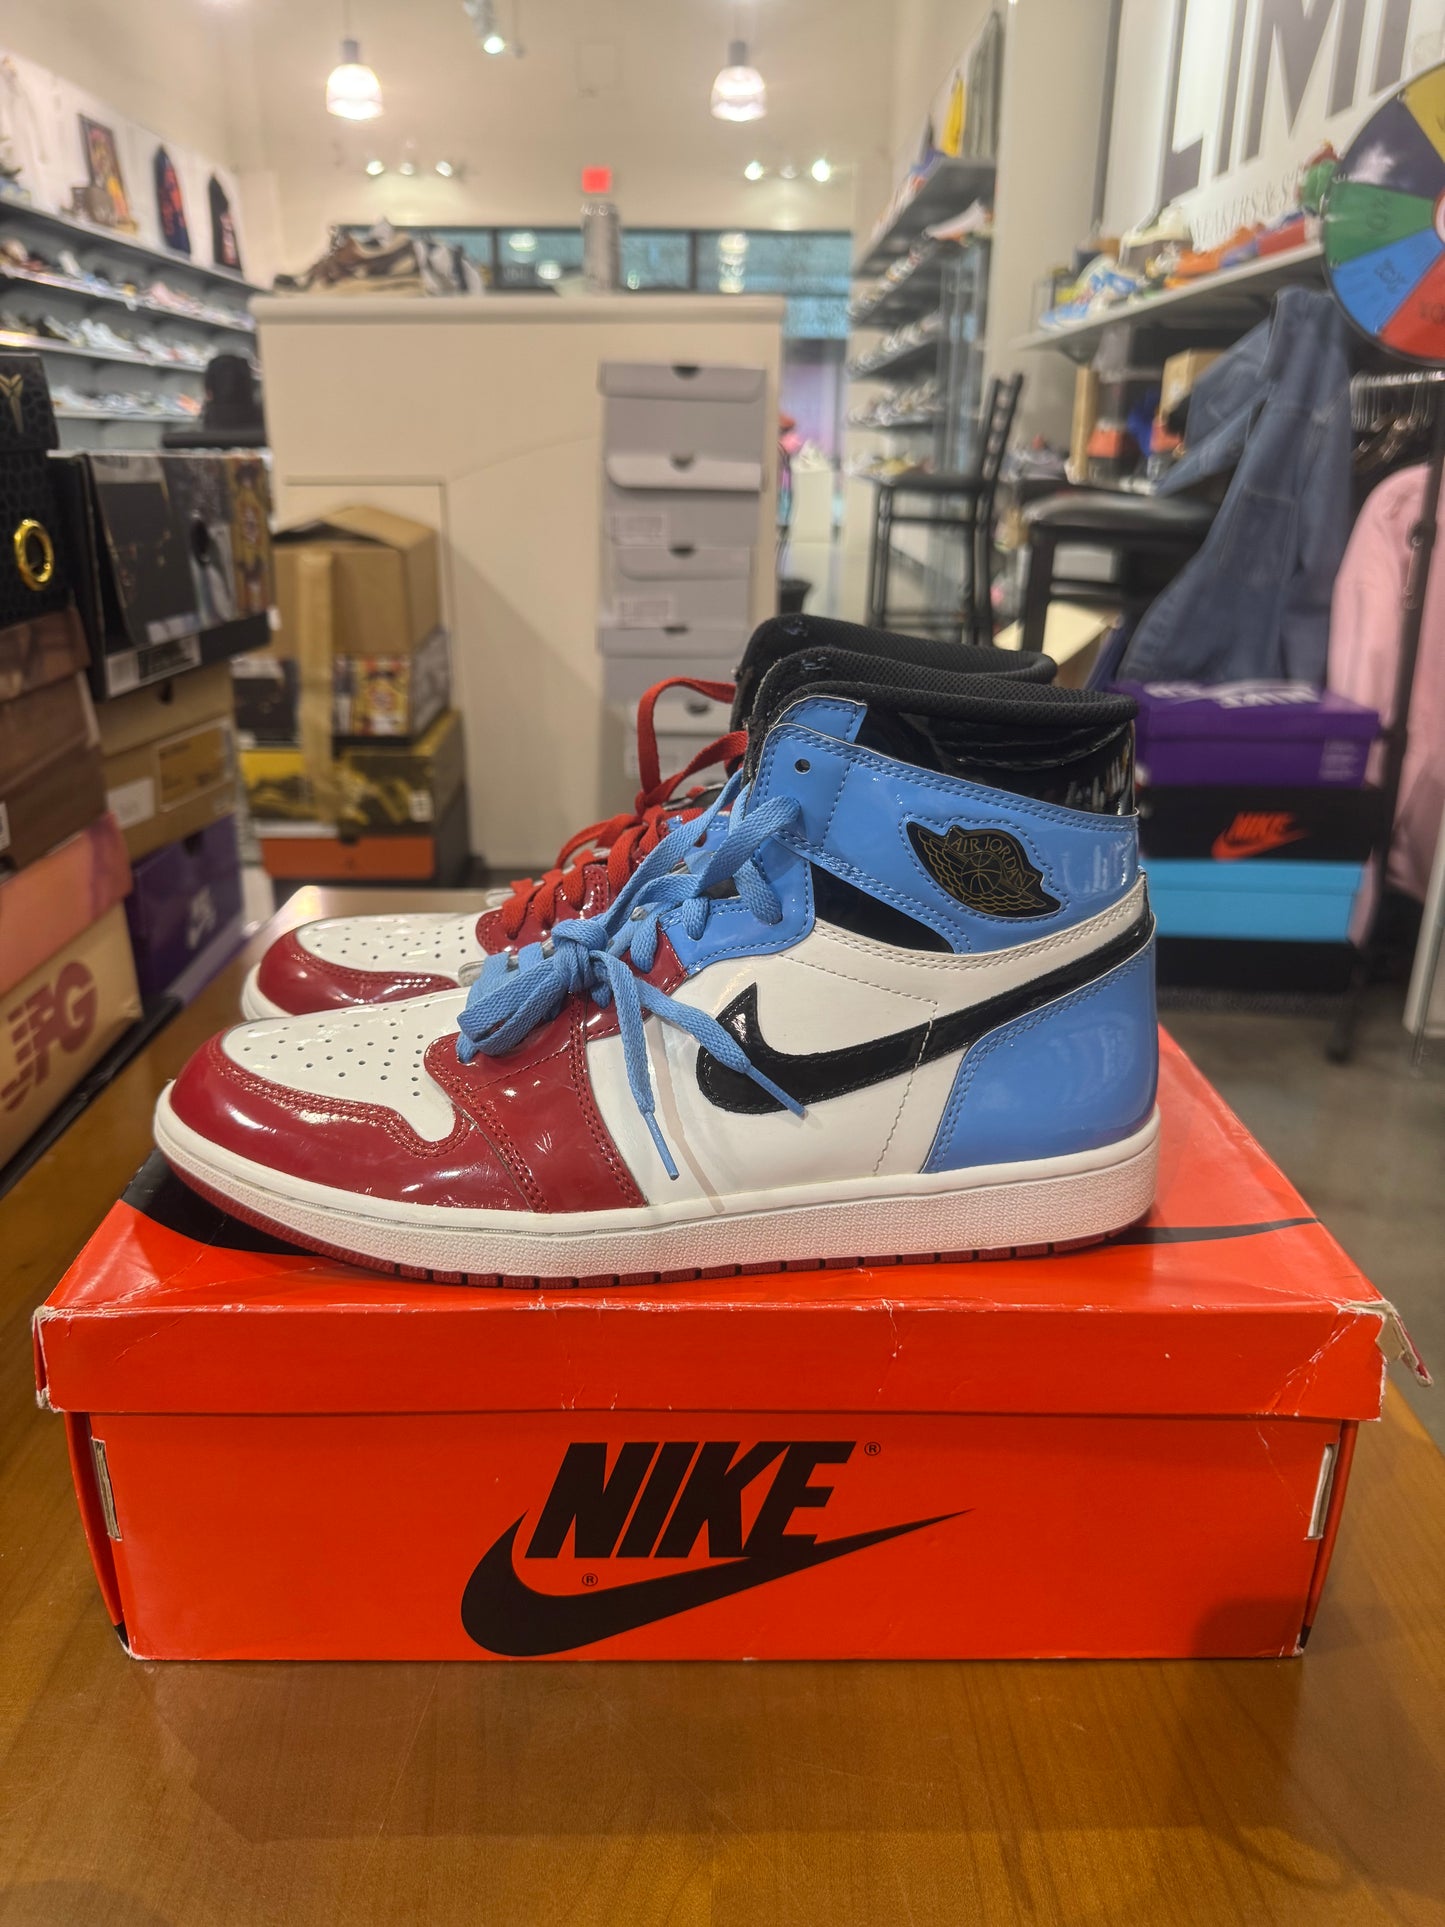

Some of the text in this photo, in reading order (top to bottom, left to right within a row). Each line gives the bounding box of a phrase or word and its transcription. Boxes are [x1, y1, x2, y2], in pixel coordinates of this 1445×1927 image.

[1225, 811, 1295, 839] NIKE
[950, 836, 1028, 890] AIR JORDAN
[524, 1440, 857, 1559] NIKE
